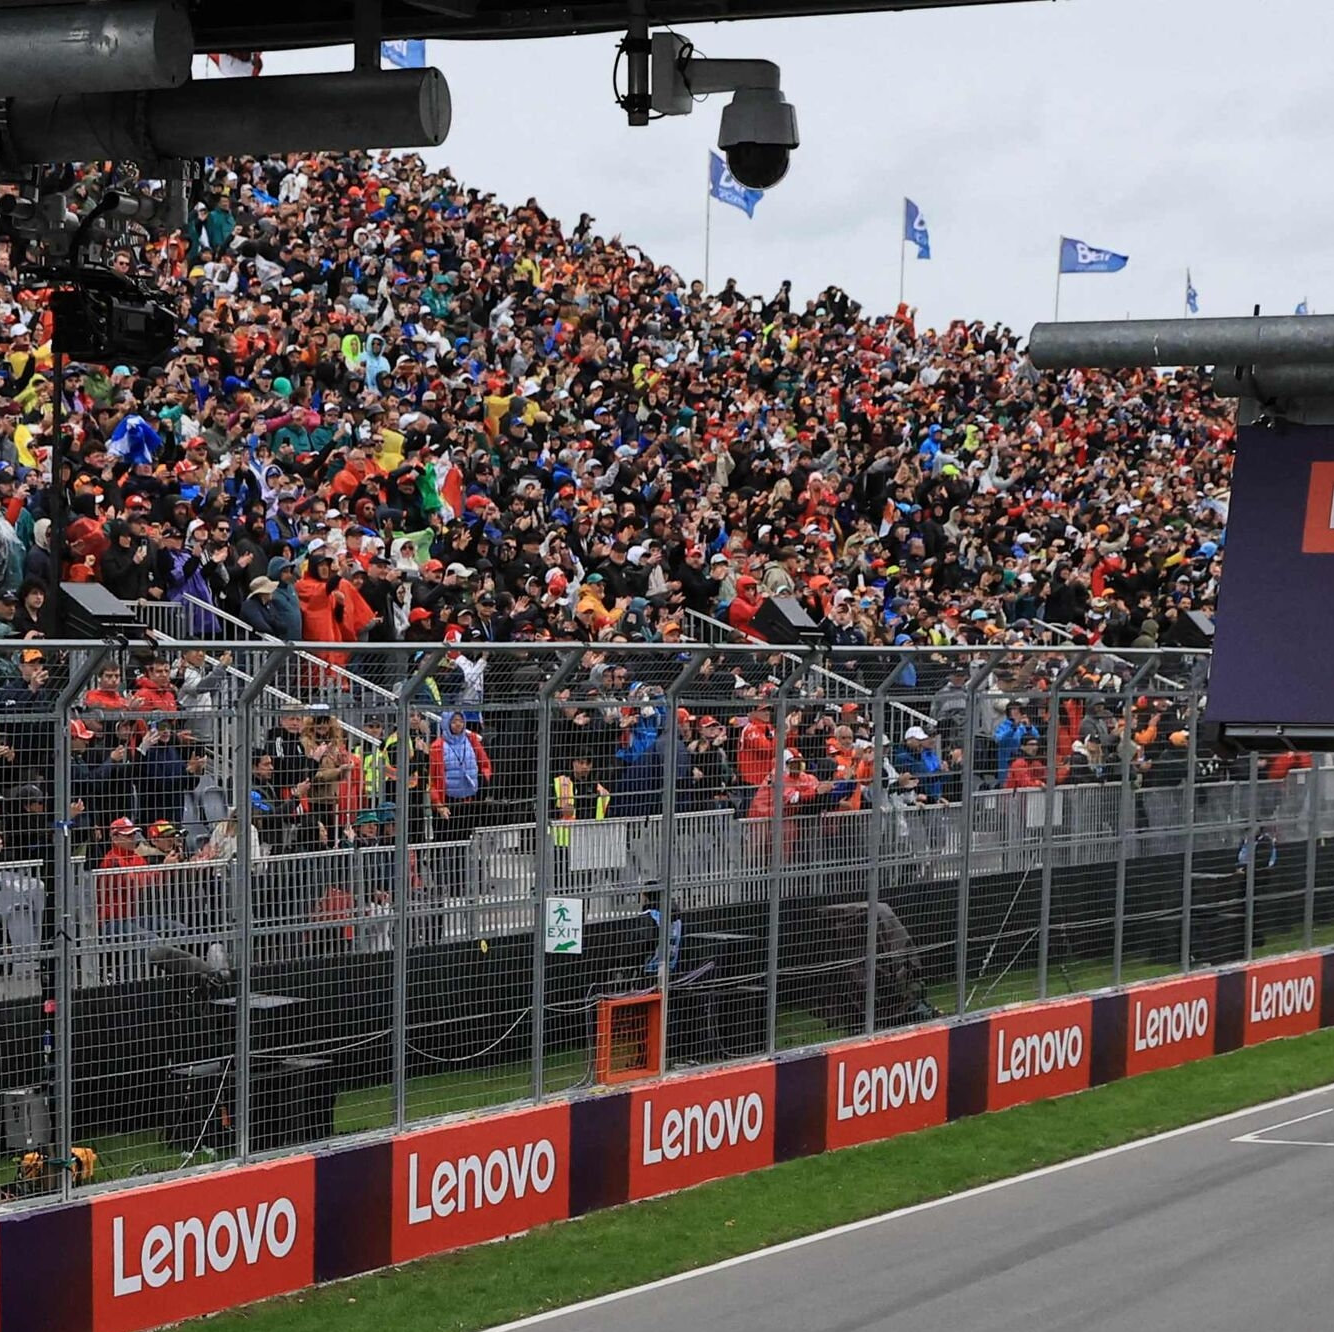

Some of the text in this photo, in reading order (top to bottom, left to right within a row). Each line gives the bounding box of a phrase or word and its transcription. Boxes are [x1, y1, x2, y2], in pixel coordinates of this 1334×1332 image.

[547, 927, 579, 939] EXIT
[1134, 997, 1208, 1051] Lenovo
[1251, 976, 1314, 1022] Lenovo
[998, 1026, 1082, 1083] Lenovo
[838, 1056, 938, 1120] Lenovo
[642, 1092, 763, 1165] Lenovo
[409, 1140, 555, 1224] Lenovo
[113, 1196, 297, 1296] Lenovo
